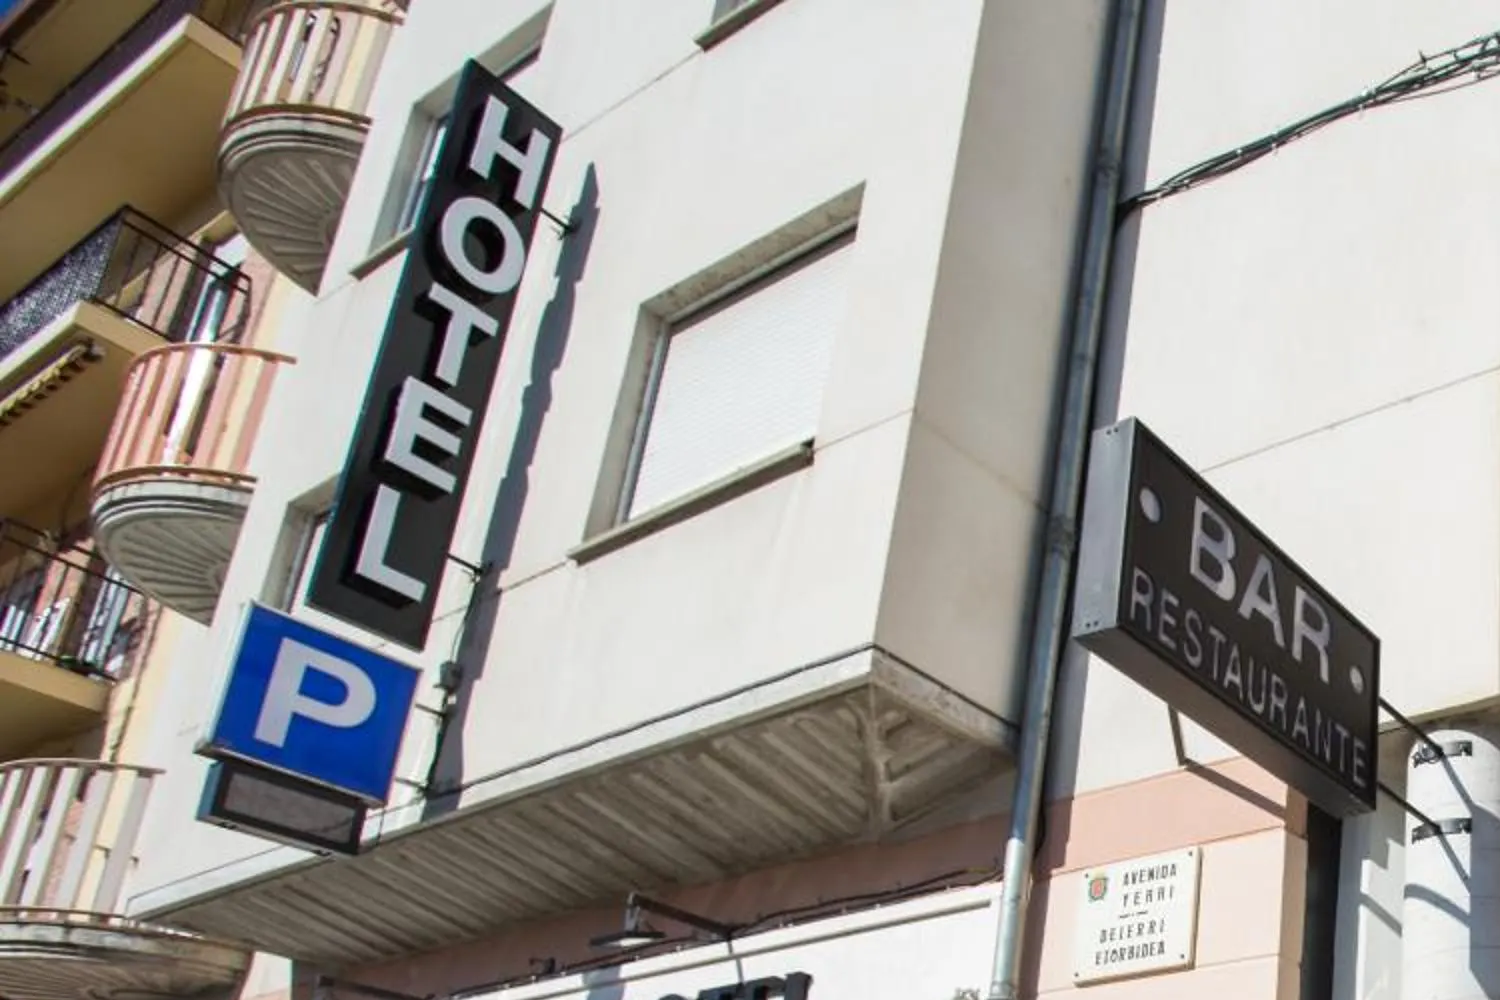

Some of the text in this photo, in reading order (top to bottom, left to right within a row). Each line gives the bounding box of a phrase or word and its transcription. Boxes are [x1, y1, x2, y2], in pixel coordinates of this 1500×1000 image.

[355, 93, 551, 604] HOTEL
[1129, 566, 1367, 788] RESTAURANTE
[1189, 495, 1331, 685] BAR
[253, 636, 377, 749] P
[1122, 863, 1177, 886] AVENIDA
